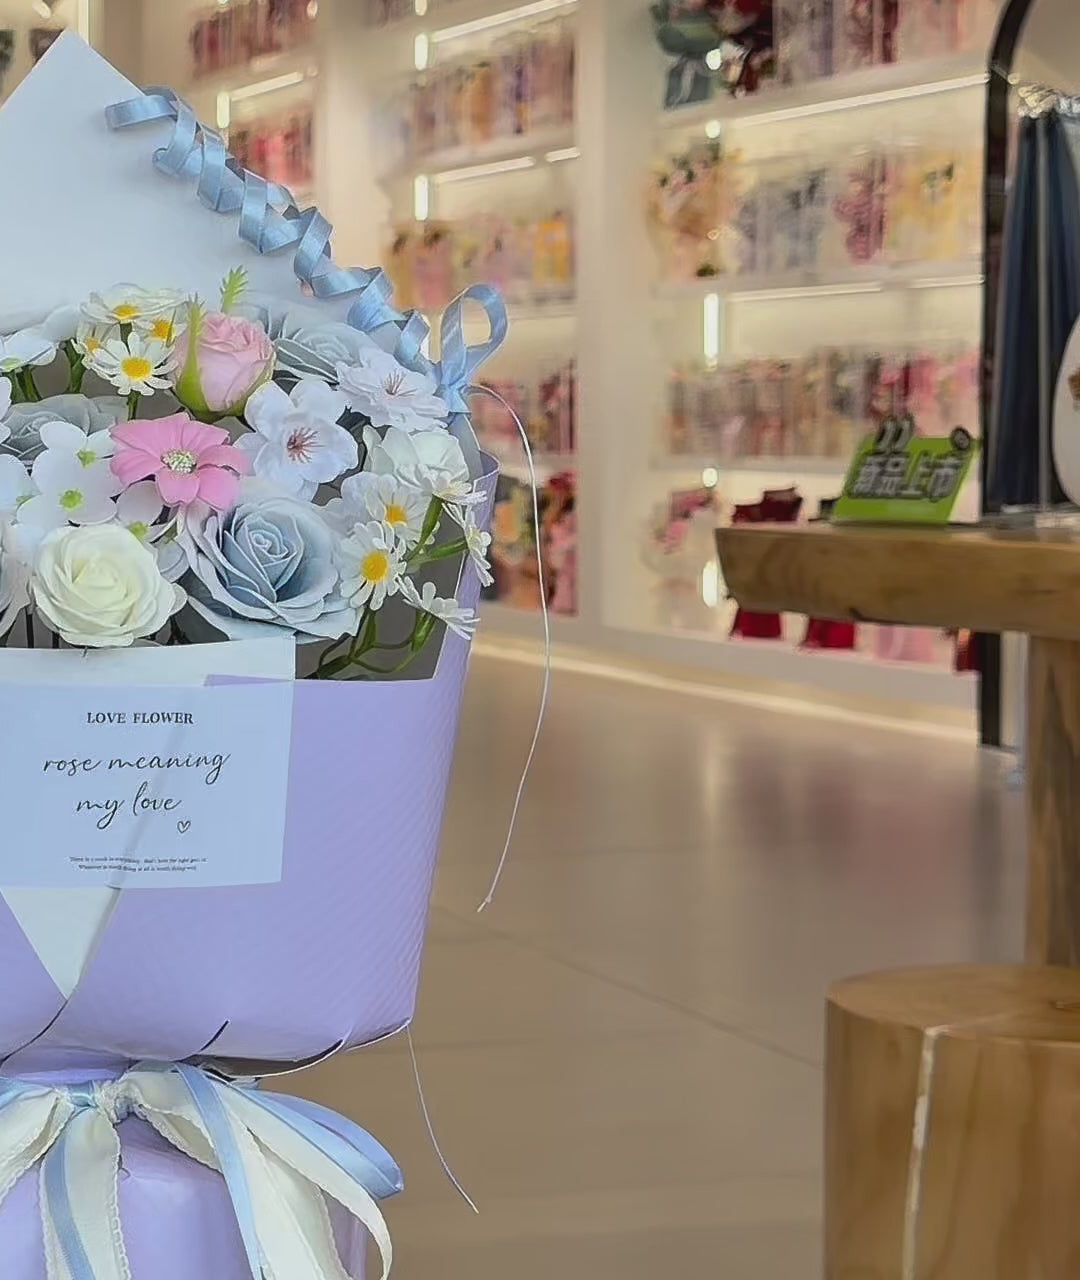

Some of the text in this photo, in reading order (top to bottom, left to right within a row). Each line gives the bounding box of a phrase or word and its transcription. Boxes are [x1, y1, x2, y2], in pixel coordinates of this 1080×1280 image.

[853, 454, 963, 498] 新品上市
[87, 712, 194, 725] LOVE FLOWER
[42, 752, 232, 785] rose meaning
[76, 781, 182, 830] my love
